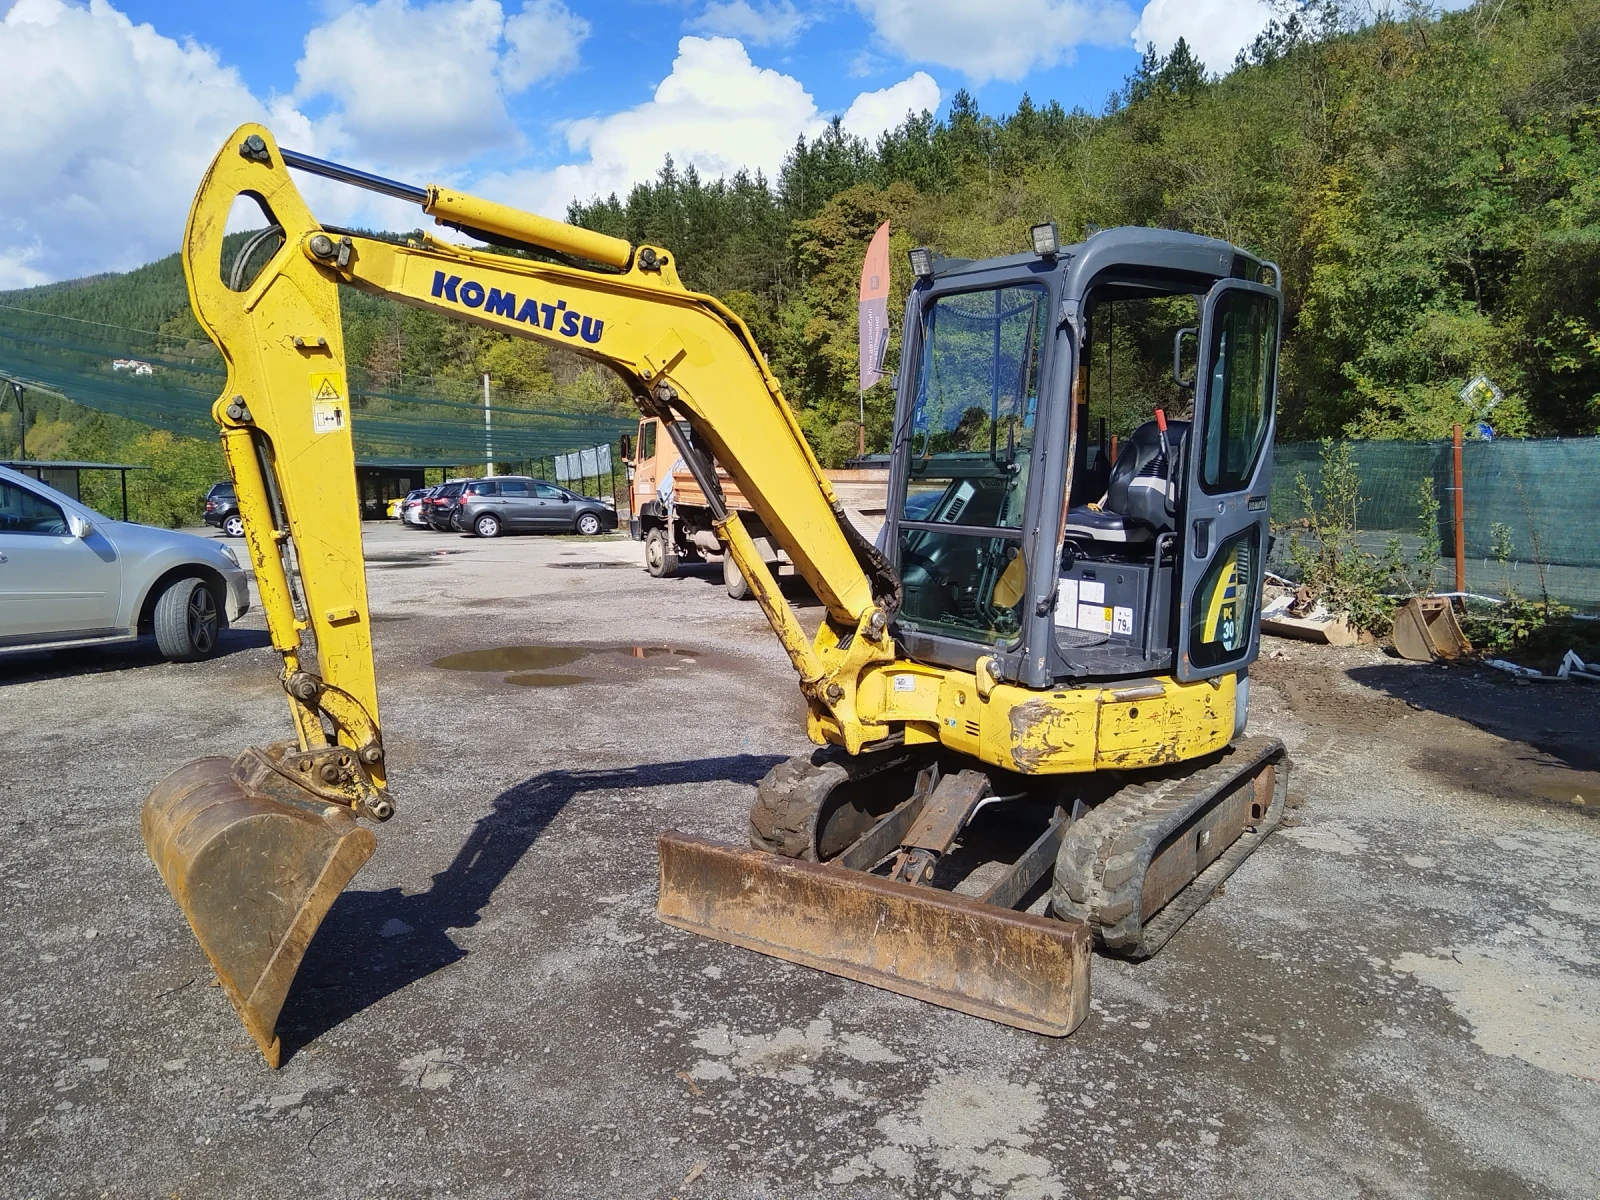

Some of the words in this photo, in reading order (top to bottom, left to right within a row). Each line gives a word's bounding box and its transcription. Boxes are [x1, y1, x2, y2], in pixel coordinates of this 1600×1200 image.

[431, 270, 604, 343] KOMATSU
[1223, 607, 1233, 621] PC
[1118, 619, 1126, 631] 79
[1223, 621, 1235, 639] 30
